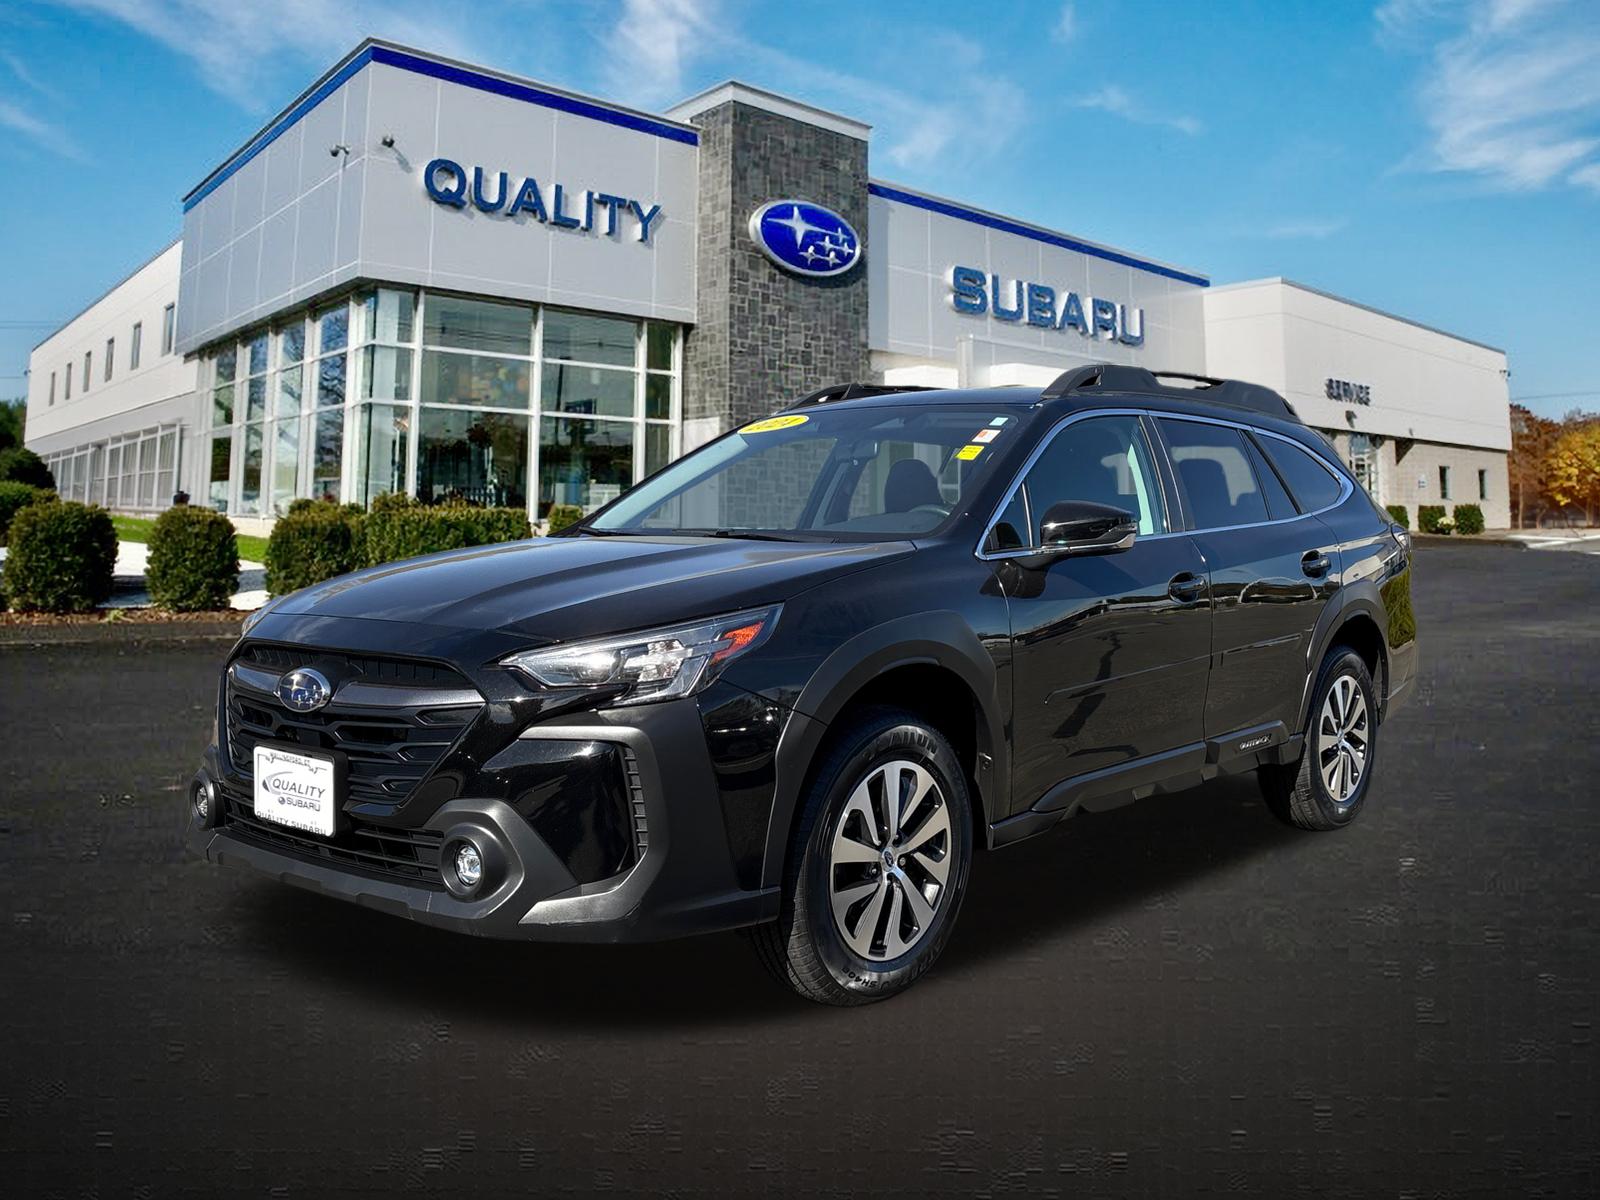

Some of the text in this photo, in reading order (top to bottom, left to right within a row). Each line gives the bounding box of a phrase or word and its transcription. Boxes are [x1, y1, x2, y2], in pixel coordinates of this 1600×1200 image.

[424, 158, 661, 243] QUALITY
[949, 265, 1145, 346] SUBARU
[272, 778, 326, 798] QUALITY
[286, 797, 321, 812] SUBARU
